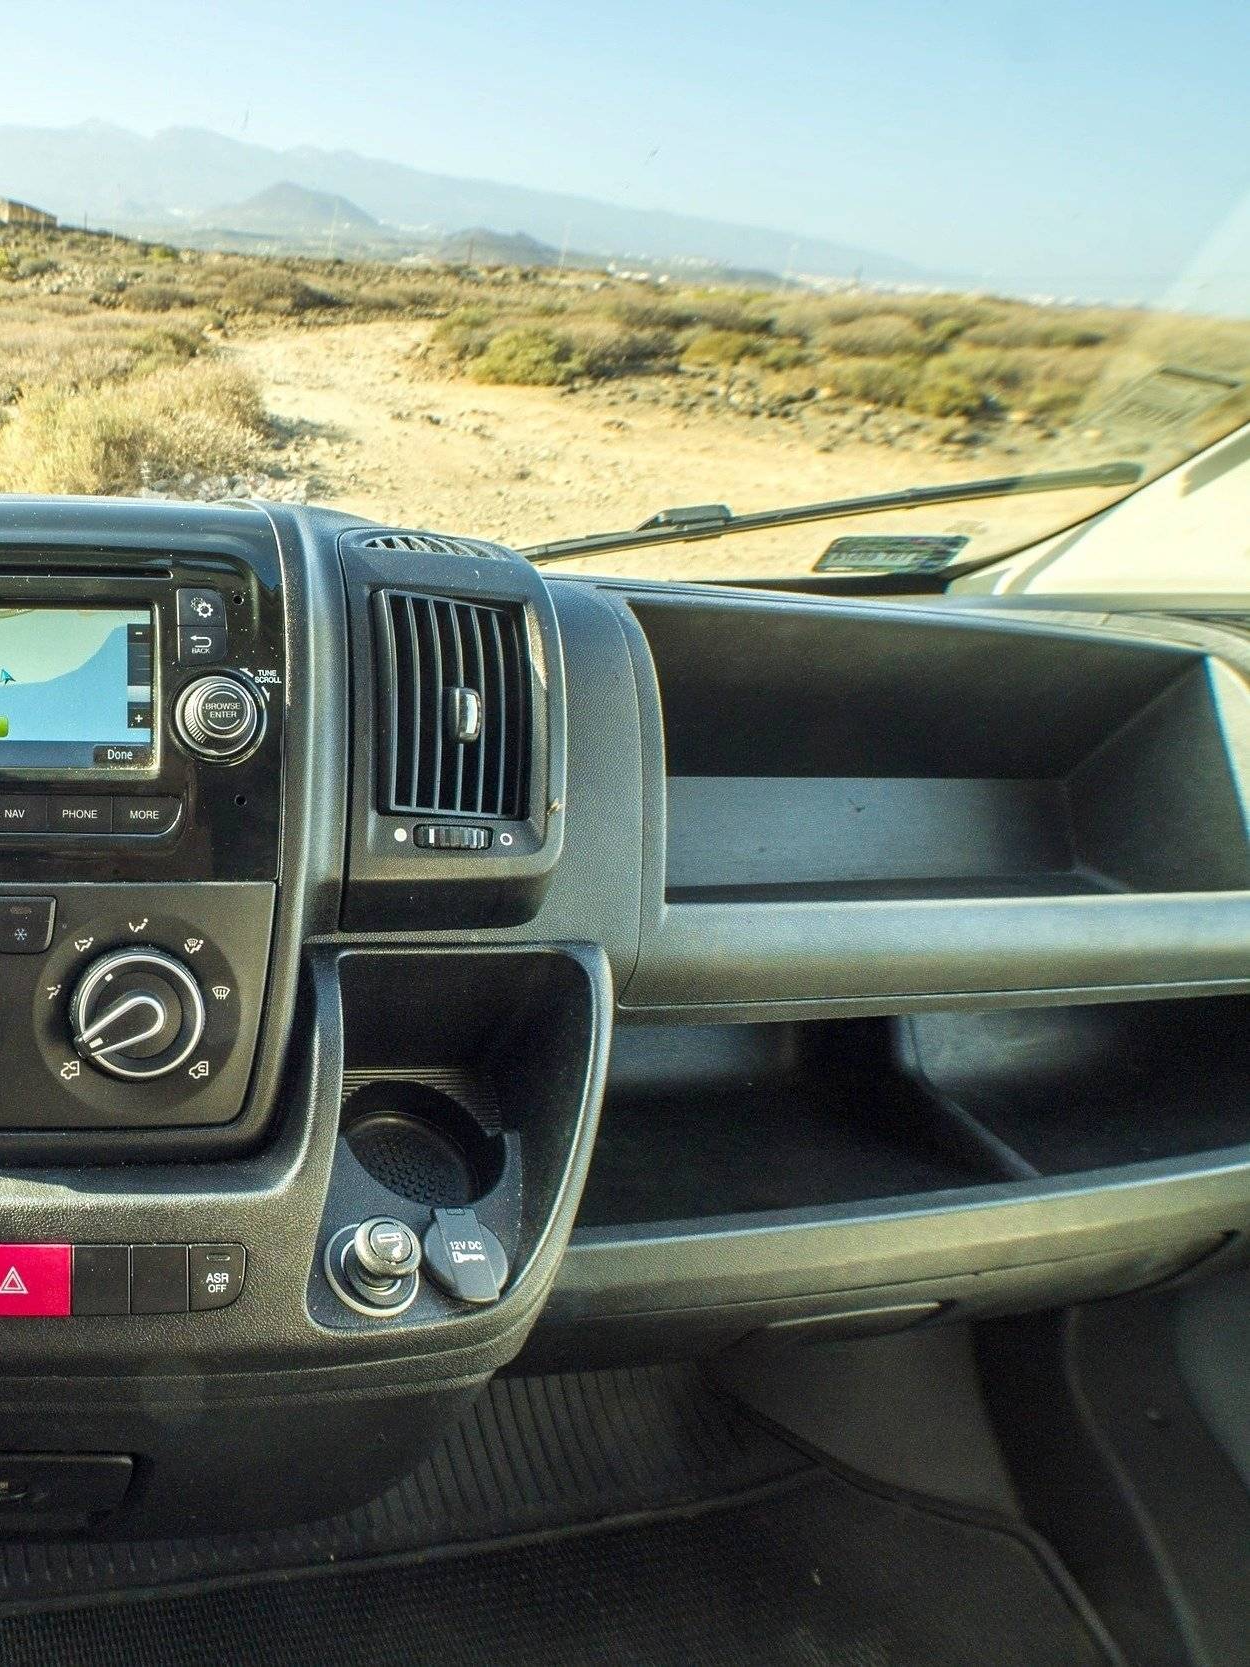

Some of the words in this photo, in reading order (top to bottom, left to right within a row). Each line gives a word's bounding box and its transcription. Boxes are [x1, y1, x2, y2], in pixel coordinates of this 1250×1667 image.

[257, 669, 277, 677] TUNE
[254, 676, 282, 684] SCROLL
[205, 702, 241, 711] BROWSE
[209, 711, 237, 719] ENTER
[107, 749, 133, 760] Done
[4, 809, 26, 819] NAV
[62, 809, 98, 819] PHONE
[129, 810, 160, 820] MORE
[449, 1240, 466, 1250] 12V
[467, 1240, 483, 1250] DC
[205, 1272, 230, 1284] ASR
[207, 1284, 227, 1293] OFF
